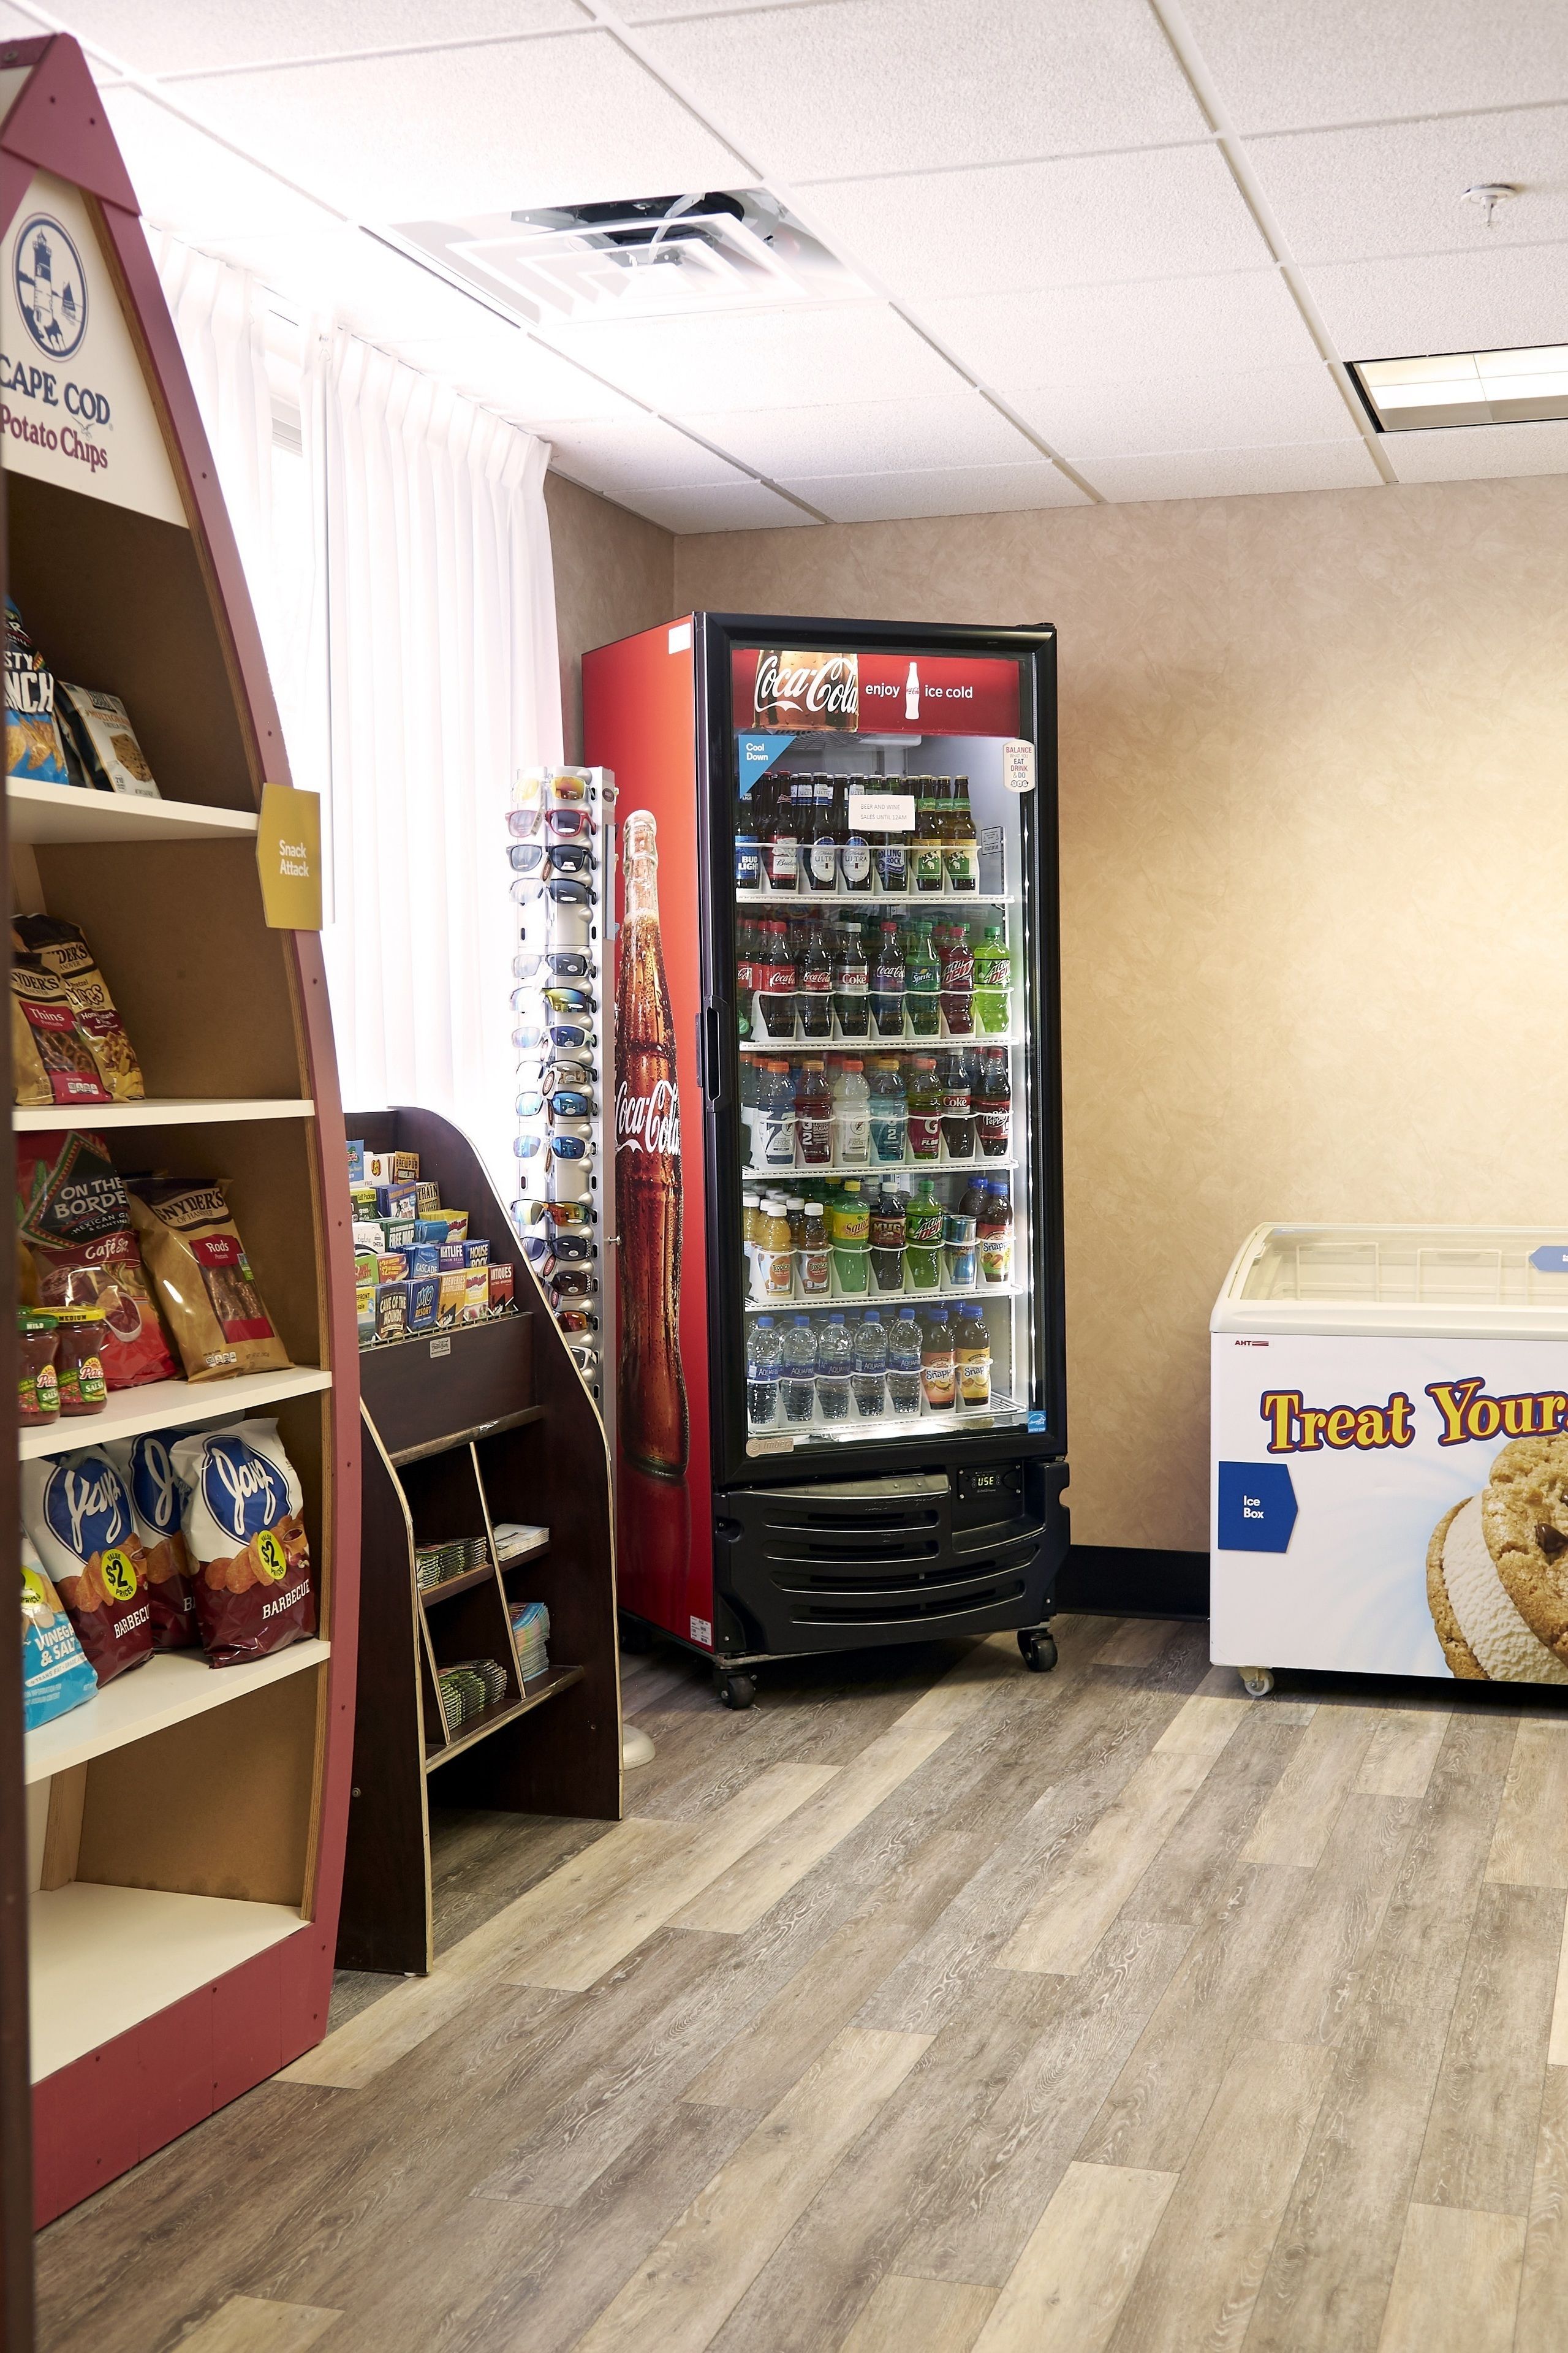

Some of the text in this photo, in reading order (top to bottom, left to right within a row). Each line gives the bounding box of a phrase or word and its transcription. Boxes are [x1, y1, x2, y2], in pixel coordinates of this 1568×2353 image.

[0, 353, 110, 425] CAPE COD
[0, 403, 108, 473] Potato Chips
[4, 651, 33, 670] STY
[754, 655, 858, 714] Coca-Cola
[865, 683, 900, 698] enjoy
[925, 684, 943, 697] ice
[945, 686, 973, 699] cold
[4, 672, 54, 713] NCH
[746, 743, 765, 752] Cool
[746, 752, 768, 761] Down
[279, 839, 307, 858] Snack
[279, 858, 309, 877] Attack
[886, 857, 901, 865] ROCK
[842, 974, 867, 985] Coke
[913, 972, 933, 983] Sprite
[29, 1007, 65, 1022] Thins
[942, 1097, 967, 1107] Coke
[615, 1080, 680, 1156] Coca-Cola
[61, 1176, 124, 1200] ON THE
[417, 1184, 439, 1200] TRAIN
[55, 1191, 127, 1219] BORDE
[155, 1191, 225, 1221] SNYDER'S
[72, 1214, 115, 1233] MEXICAN
[96, 1219, 127, 1229] CANTIN
[874, 1223, 901, 1232] MUG
[390, 1230, 414, 1247] FREE MAP
[85, 1237, 116, 1259] Café
[205, 1240, 230, 1253] Rods
[469, 1244, 488, 1259] HOUSE
[415, 1263, 437, 1274] CASCADE
[491, 1266, 512, 1281] ANTIQUES
[442, 1275, 466, 1287] BREWERIES
[380, 1296, 392, 1314] CAVE
[392, 1295, 398, 1309] OF
[415, 1306, 432, 1318] RESORT
[383, 1309, 402, 1325] MOUNDS
[1262, 1379, 1568, 1452] Treat Your
[978, 1476, 994, 1486] USE
[1243, 1495, 1260, 1506] Ice
[1243, 1507, 1265, 1518] Box
[261, 1534, 272, 1542] VALUE
[107, 1552, 121, 1561] VALUE
[262, 1539, 279, 1567] $2
[105, 1559, 129, 1588] $2
[271, 1566, 284, 1577] PRICED
[115, 1585, 134, 1597] PRICED
[262, 1579, 310, 1620] BARBECUE
[114, 1604, 150, 1639] BARBECU
[35, 1623, 75, 1651] VINEGA
[40, 1651, 53, 1667] &
